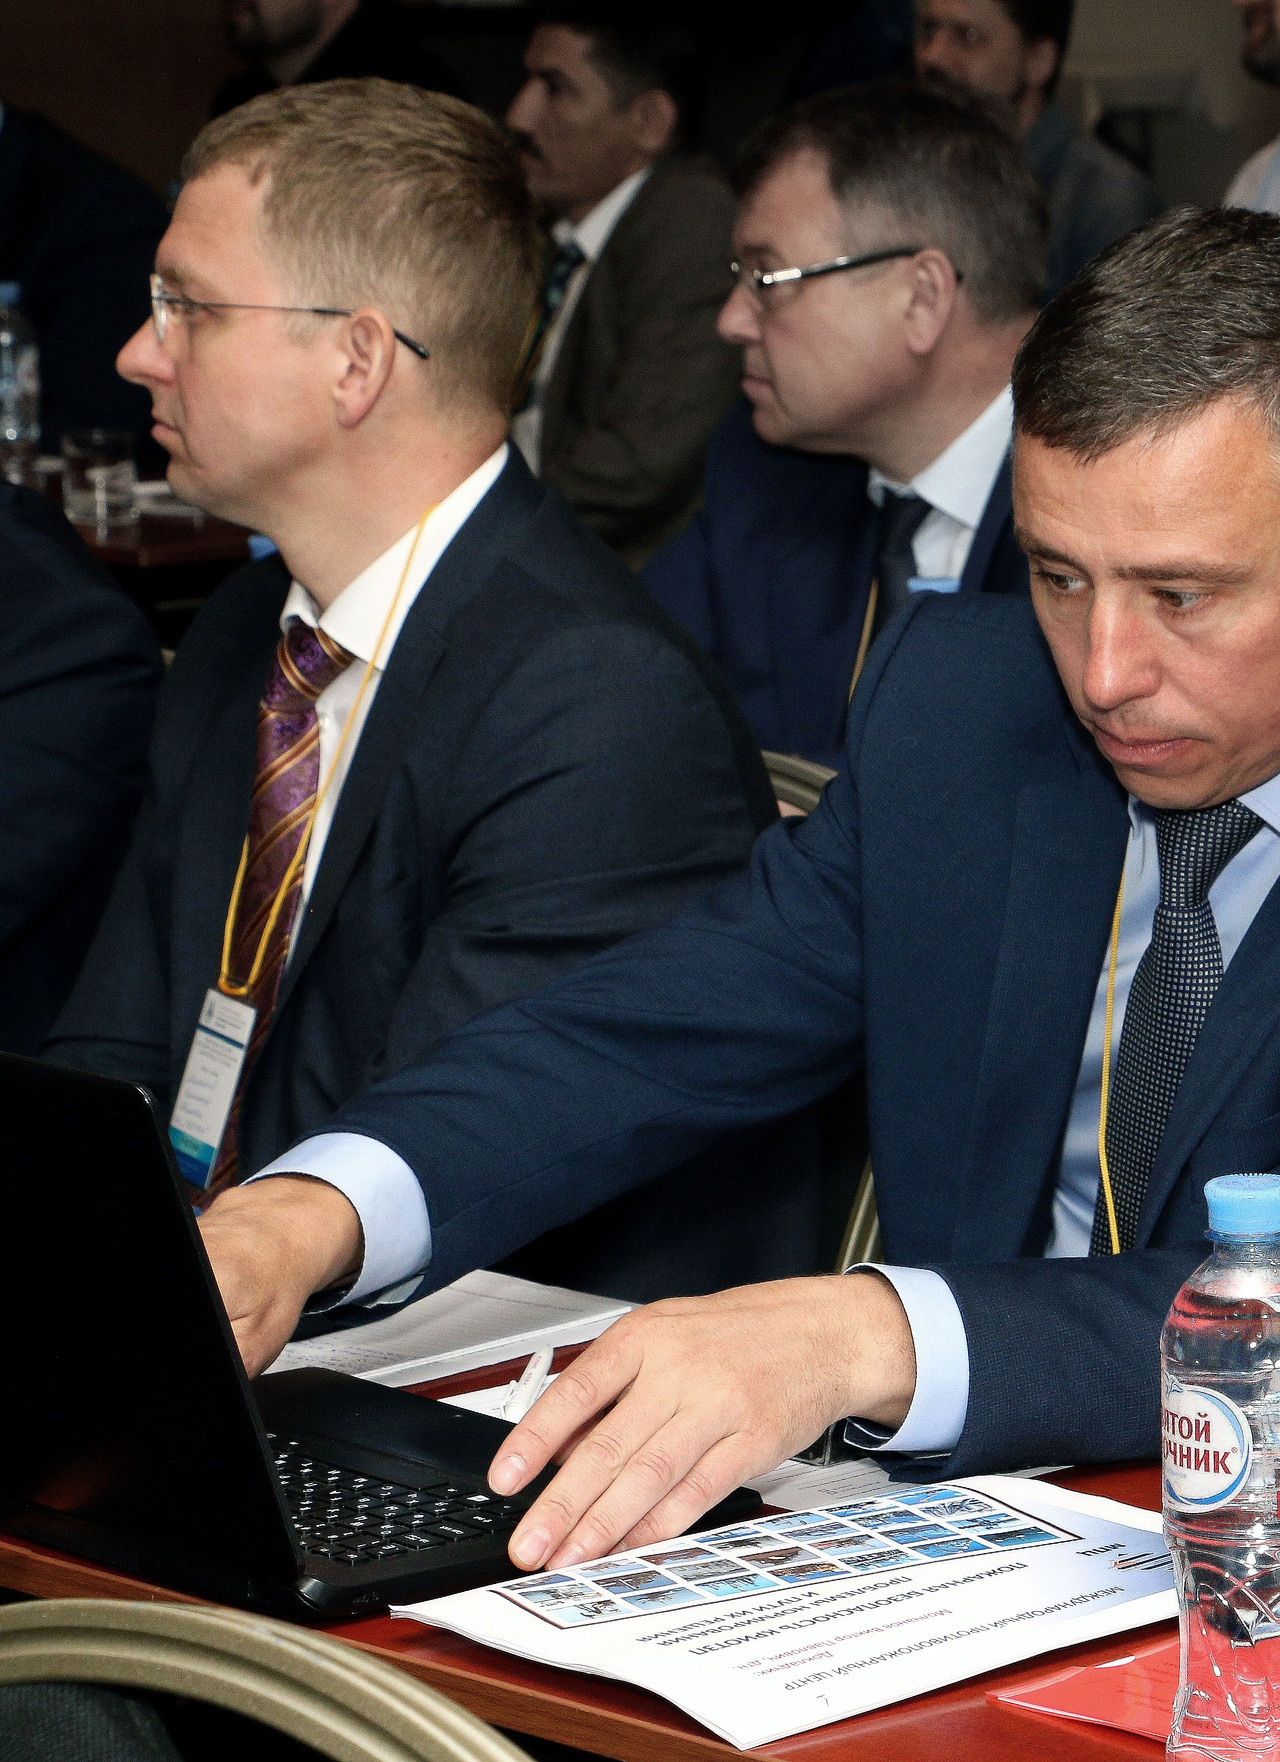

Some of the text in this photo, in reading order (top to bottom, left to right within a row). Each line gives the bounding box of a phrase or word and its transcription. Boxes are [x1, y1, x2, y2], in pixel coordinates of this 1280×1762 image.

[922, 1561, 1029, 1593] ПОЖАРНАЯ
[657, 1575, 913, 1647] ПРОБЛЕМЫ НОРМИРОВАНИЯ
[728, 1607, 751, 1620] ИХ
[752, 1597, 803, 1615] ПУТИ
[779, 1587, 926, 1632] БЕЗОПАСНОСТЬ
[882, 1608, 952, 1631] Молчанов
[635, 1616, 727, 1643] РЕШЕНИЯ
[784, 1585, 1125, 1691] МЕЖДУНАРОДНЫЙ ПРОТИВОПОЖАРНЫЙ ЦЕНТР
[834, 1625, 883, 1643] Виктор
